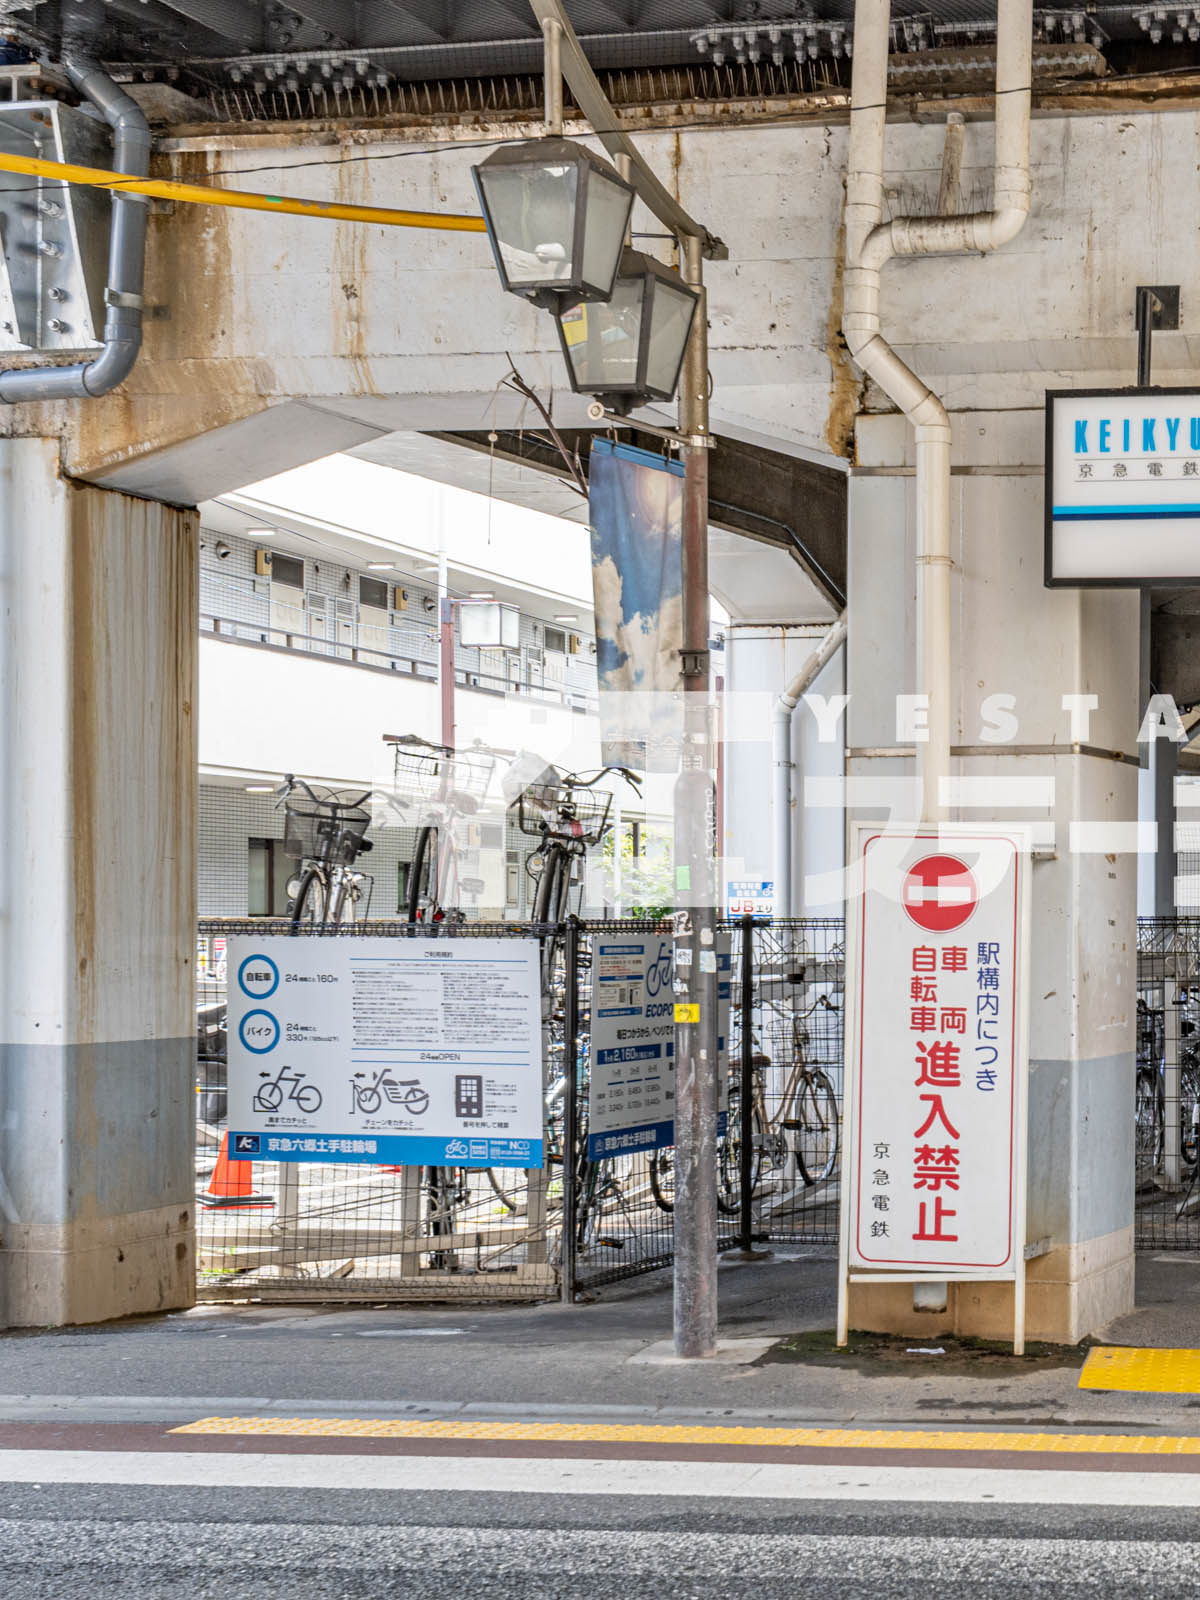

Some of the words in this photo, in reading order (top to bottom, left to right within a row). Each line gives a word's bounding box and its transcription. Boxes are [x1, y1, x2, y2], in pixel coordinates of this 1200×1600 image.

[1079, 461, 1200, 478] 京急電鉄
[247, 973, 271, 982] 自転車
[247, 1027, 272, 1036] バイク
[975, 942, 1000, 1092] 駅構内につき
[912, 1040, 961, 1243] 進入禁止
[871, 1142, 891, 1238] 京急電鉄
